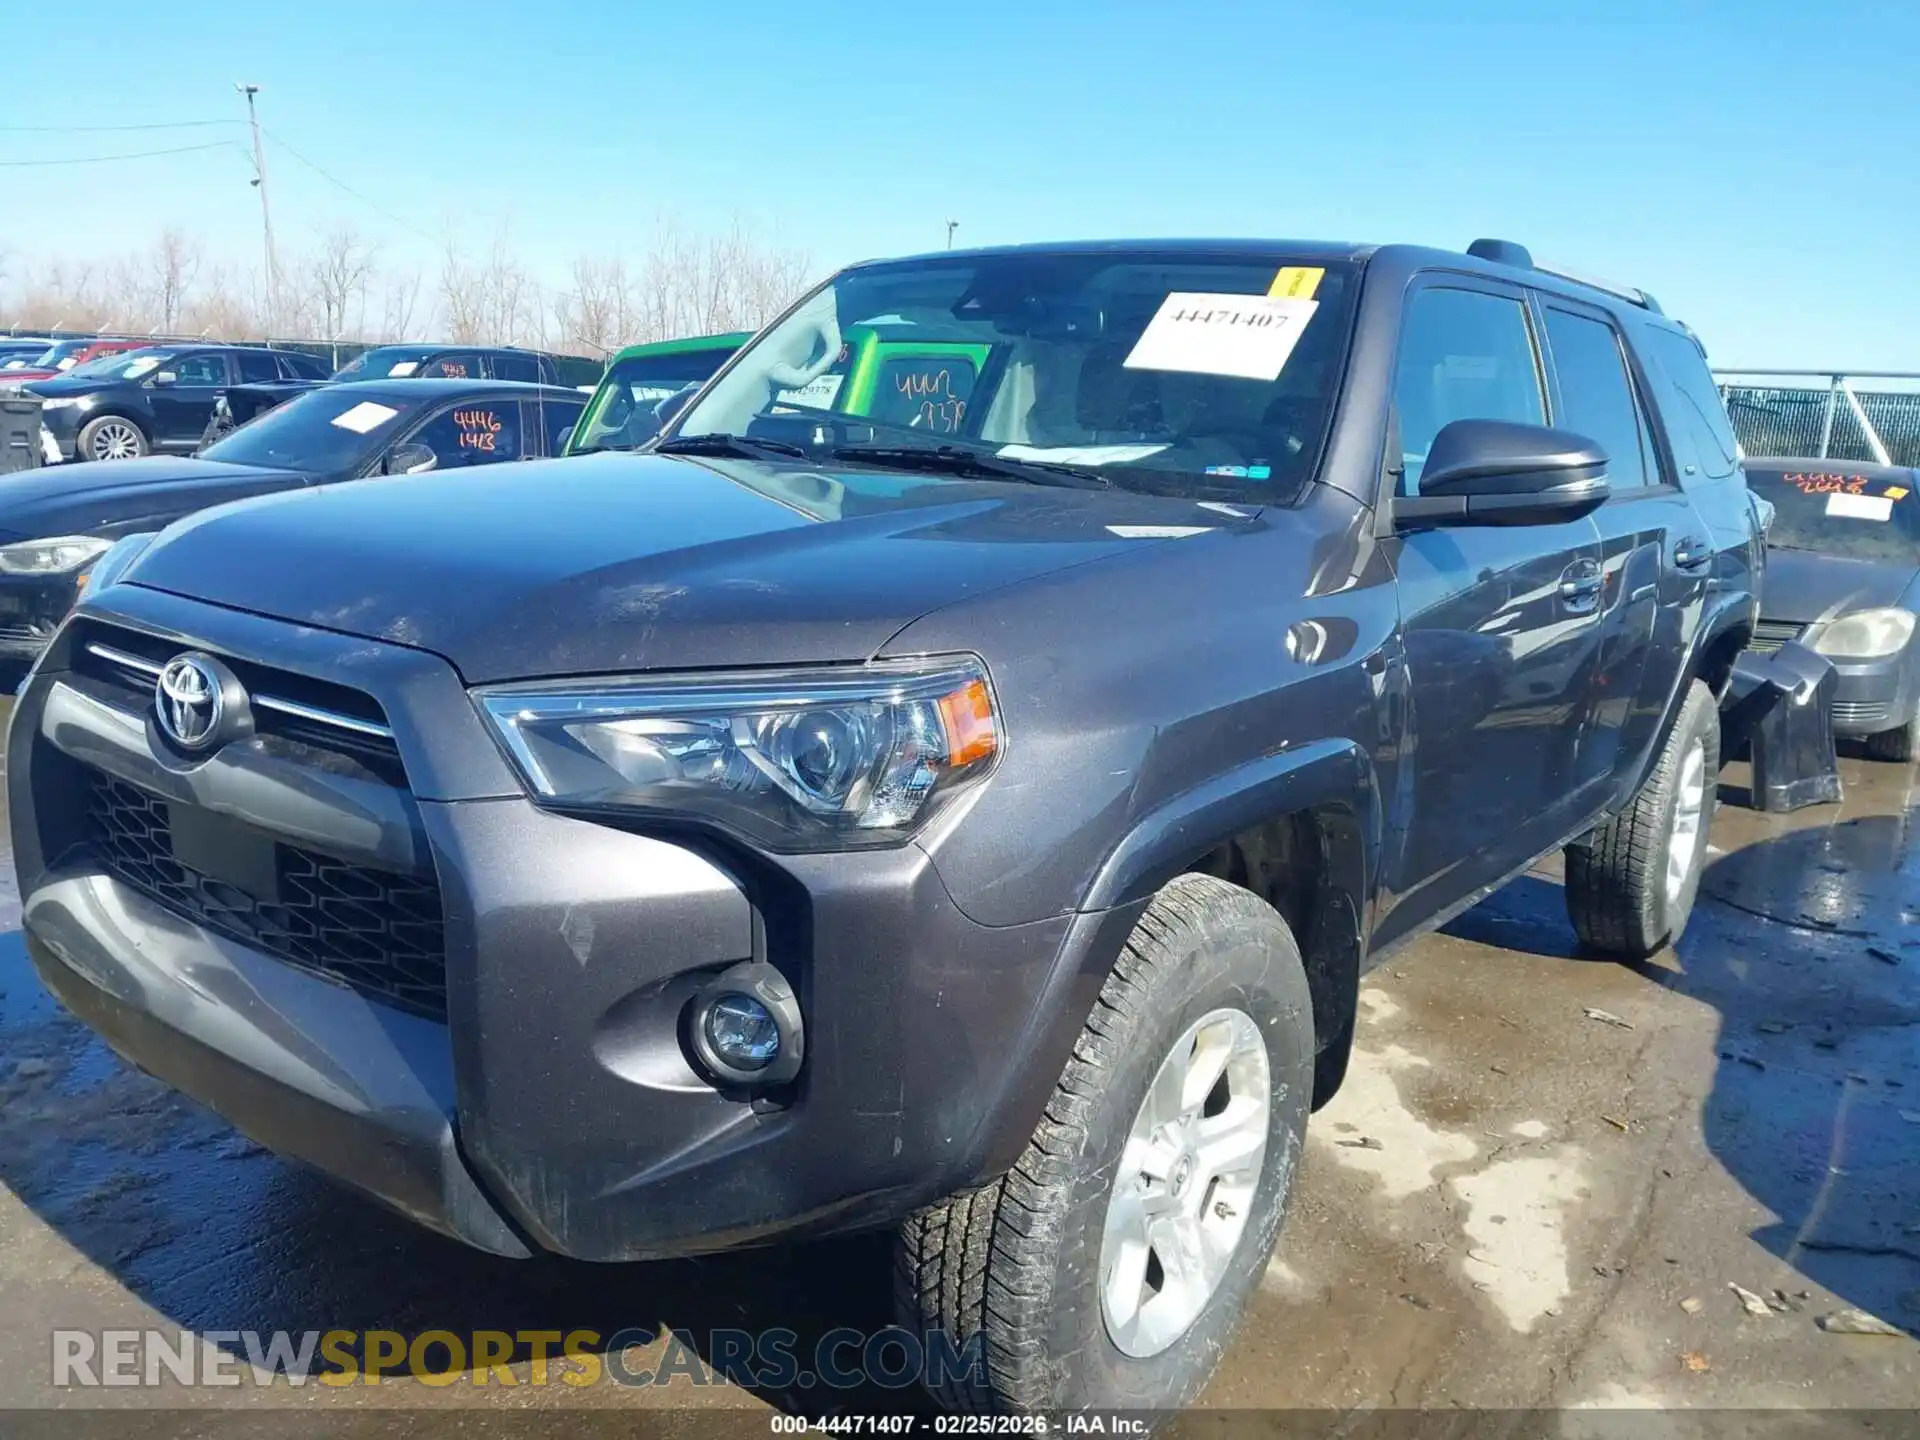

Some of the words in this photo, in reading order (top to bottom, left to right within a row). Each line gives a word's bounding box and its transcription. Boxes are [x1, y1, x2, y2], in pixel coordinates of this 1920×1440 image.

[1169, 308, 1289, 328] 44471407
[454, 411, 501, 432] 4446
[460, 432, 496, 450] 1413
